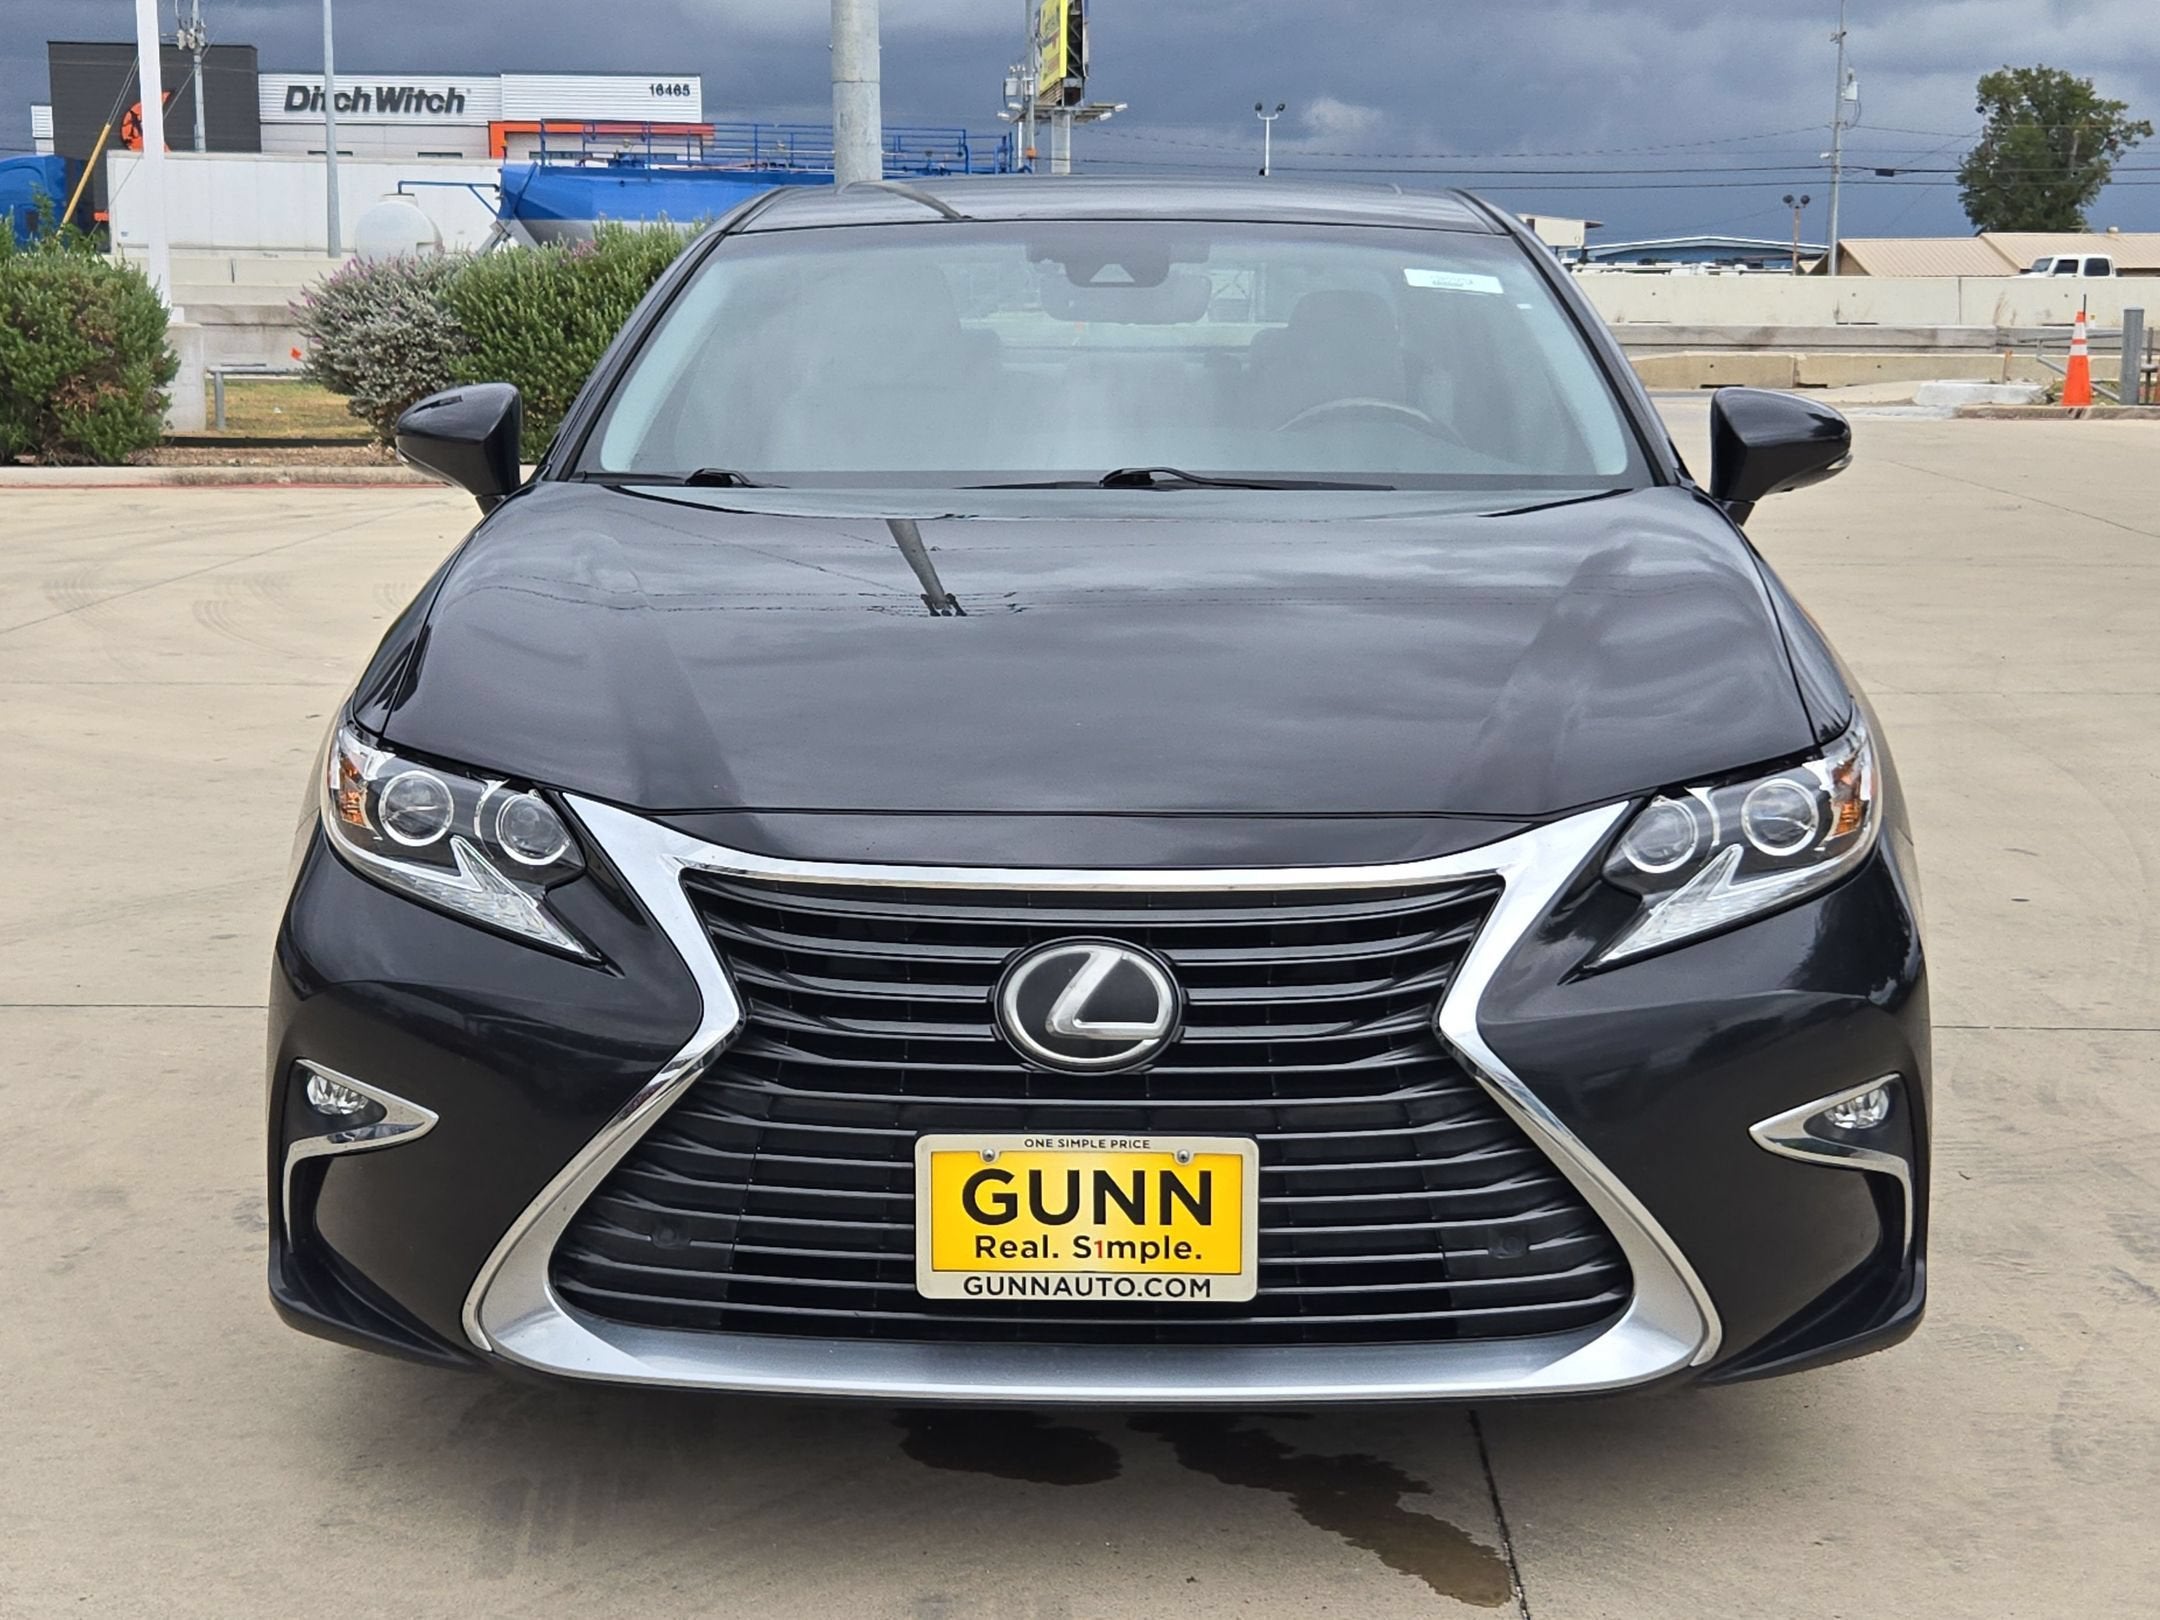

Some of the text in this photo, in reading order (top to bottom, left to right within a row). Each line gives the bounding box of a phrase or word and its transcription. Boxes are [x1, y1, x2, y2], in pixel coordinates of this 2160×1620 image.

[375, 87, 465, 114] Witch
[649, 83, 691, 97] 16465
[1024, 1138, 1151, 1150] ONE SIMPLE PRICE
[962, 1168, 1212, 1226] GUNN
[975, 1234, 1203, 1265] Real. S1mple.
[963, 1276, 1212, 1299] GUNNAUTO.COM
